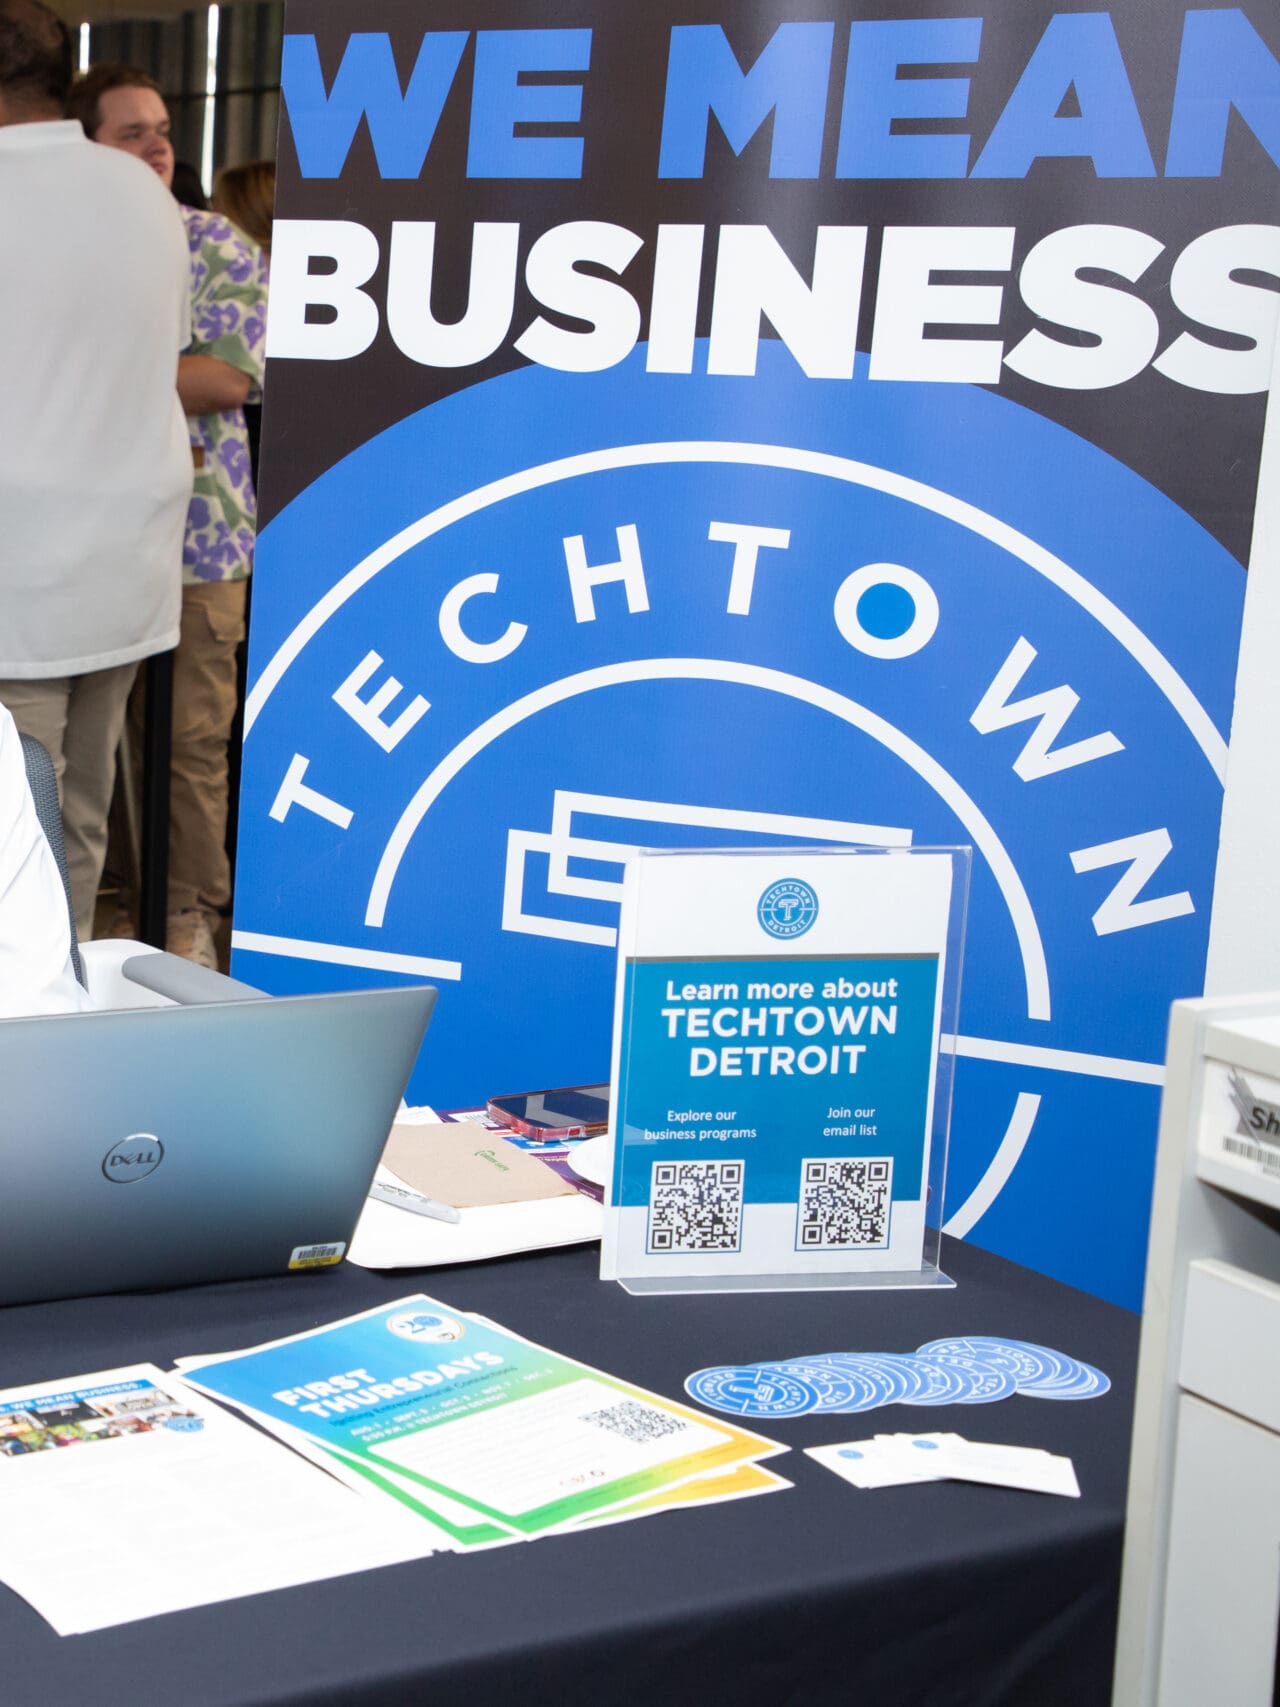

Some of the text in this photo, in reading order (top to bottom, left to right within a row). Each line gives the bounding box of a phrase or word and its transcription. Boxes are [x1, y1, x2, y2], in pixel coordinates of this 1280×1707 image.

[282, 8, 1280, 179] WE MEAN
[265, 218, 1280, 394] BUSINESS
[269, 520, 1196, 936] TECHTOWN
[766, 885, 811, 904] TECHTOWN
[767, 919, 806, 933] DETROIT
[666, 977, 898, 1001] Learn more about
[661, 1005, 898, 1038] TECHTOWN
[690, 1045, 867, 1077] DETROIT
[667, 1109, 737, 1124] Explore our
[827, 1107, 875, 1119] Join our
[644, 1128, 757, 1142] business programs
[823, 1124, 877, 1136] email list
[110, 1151, 158, 1168] DELL
[272, 1368, 376, 1406] FIRST
[298, 1351, 504, 1418] THURSDAYS
